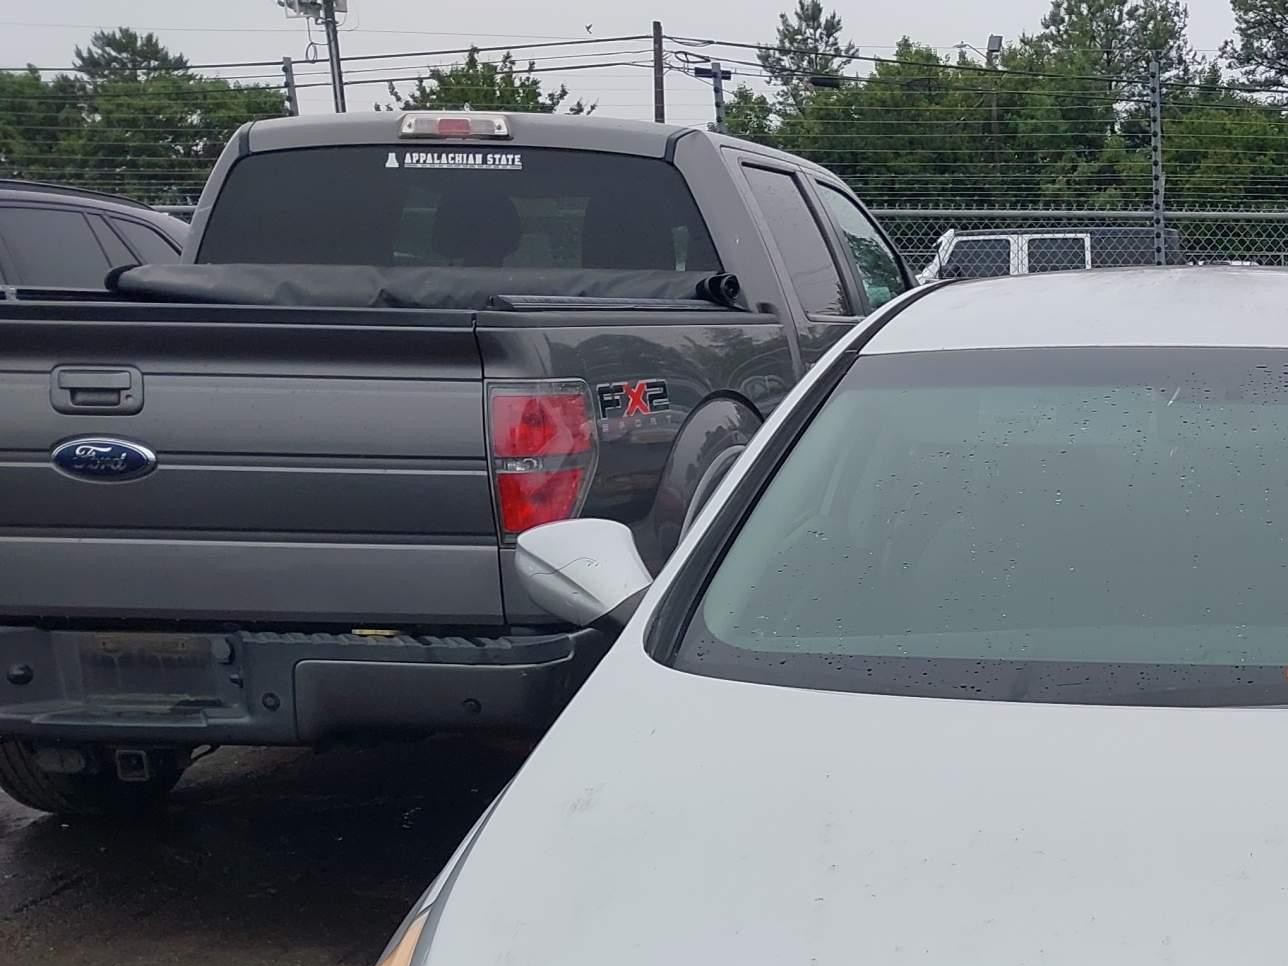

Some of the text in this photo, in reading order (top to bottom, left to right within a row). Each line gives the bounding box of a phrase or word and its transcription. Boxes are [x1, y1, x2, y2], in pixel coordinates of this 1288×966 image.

[404, 152, 522, 165] APPALACHIAN STATE
[596, 379, 671, 420] FX2
[72, 445, 128, 471] Ford
